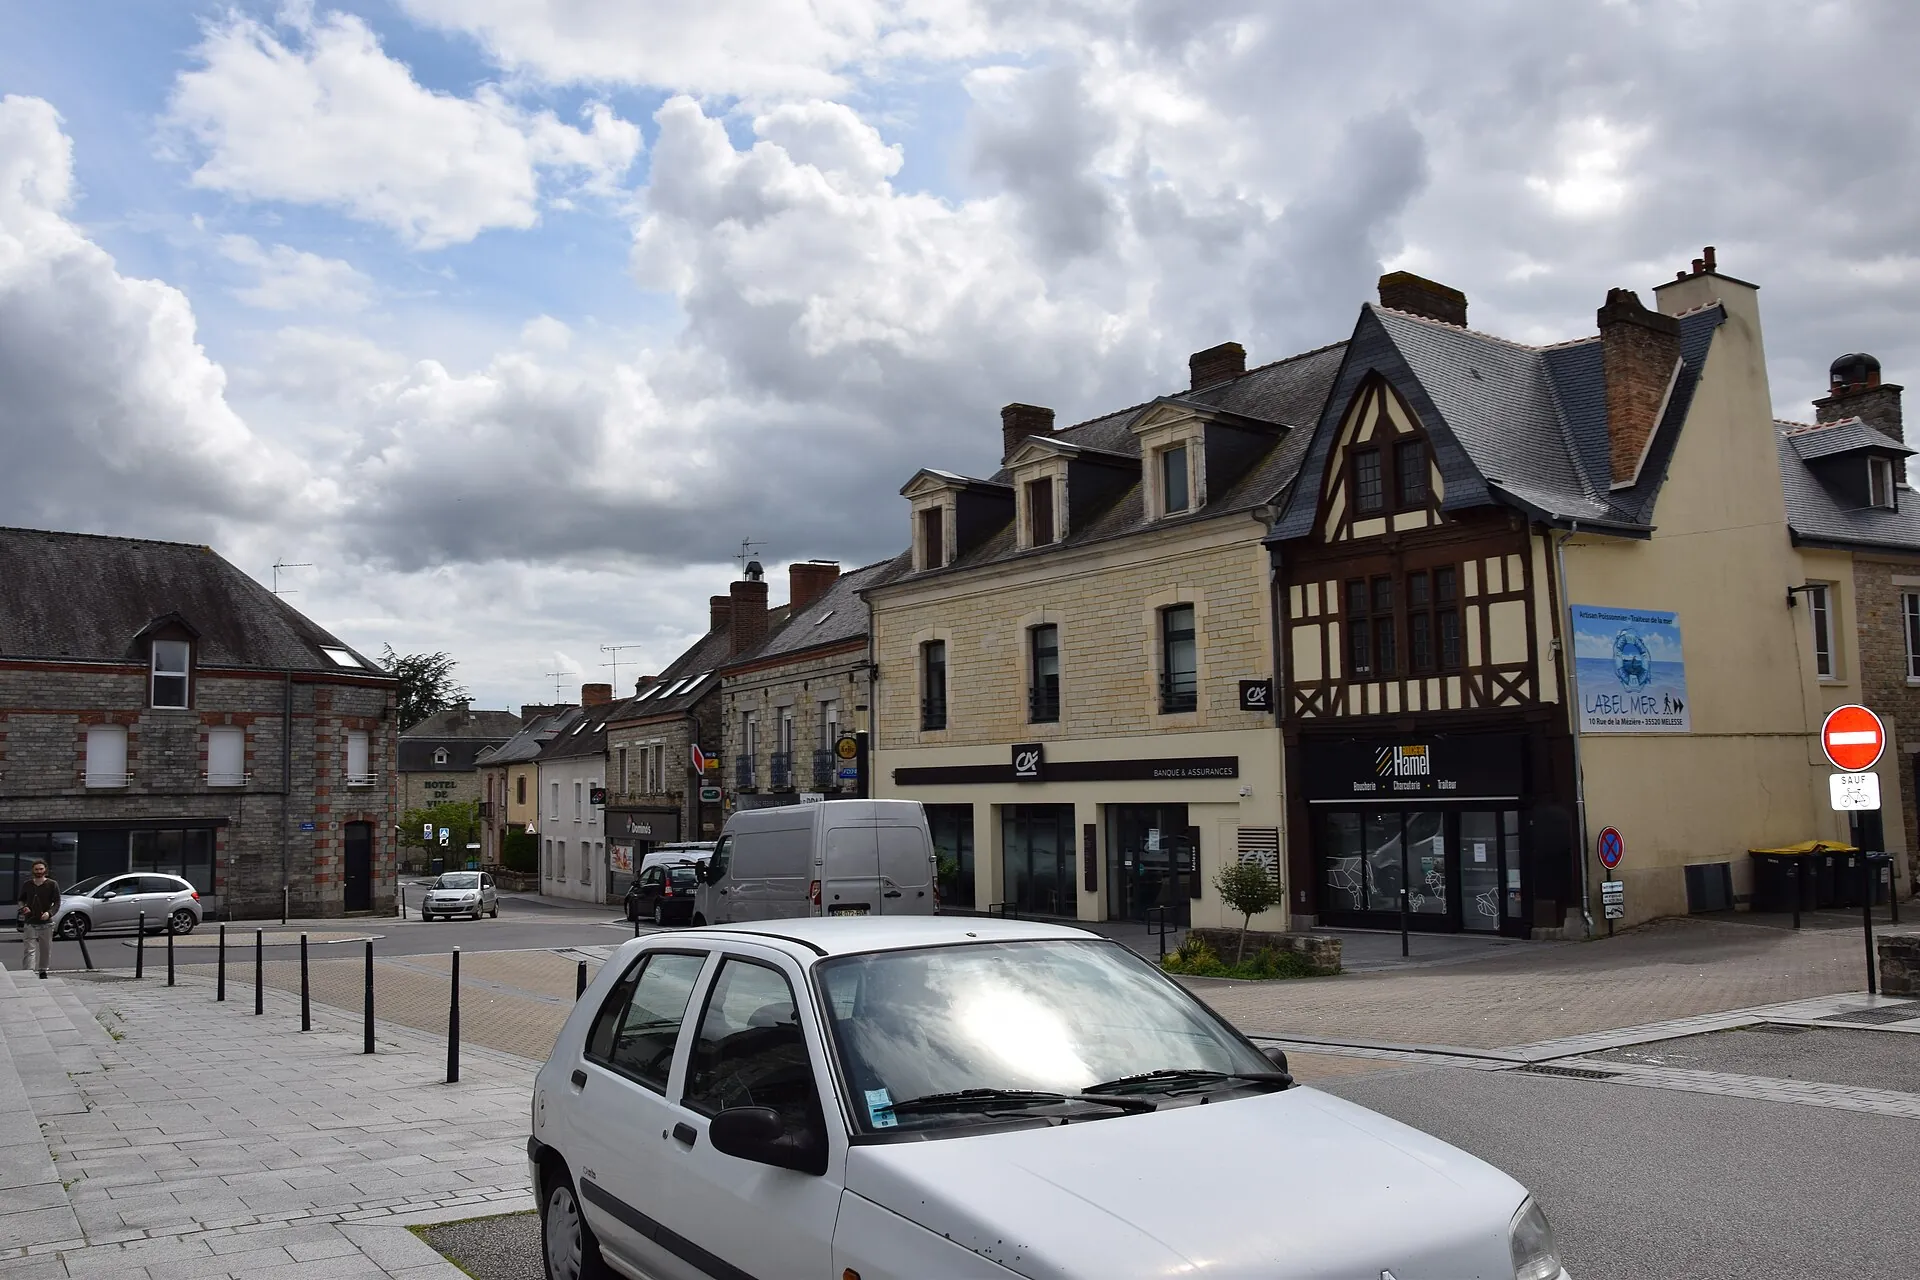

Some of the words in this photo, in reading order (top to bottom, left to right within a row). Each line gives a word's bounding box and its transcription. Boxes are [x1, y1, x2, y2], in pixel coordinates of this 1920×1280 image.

[1579, 611, 1598, 619] Artisan
[1598, 612, 1627, 621] Poissonnier
[1631, 614, 1650, 622] Traiteur
[1658, 616, 1662, 624] la
[1585, 694, 1628, 714] LABEL
[1630, 695, 1658, 714] MER
[1393, 744, 1430, 775] Hamel
[1154, 769, 1180, 777] BANQUE
[1181, 768, 1186, 776] &
[1187, 767, 1233, 776] ASSURANCES
[424, 781, 457, 789] HOTEL
[1353, 782, 1376, 791] Boucherie
[1393, 780, 1421, 790] Charcuterie
[1437, 779, 1456, 789] Traiteur
[1841, 775, 1866, 785] SAUF
[434, 790, 448, 798] DE
[631, 821, 651, 834] Domino's
